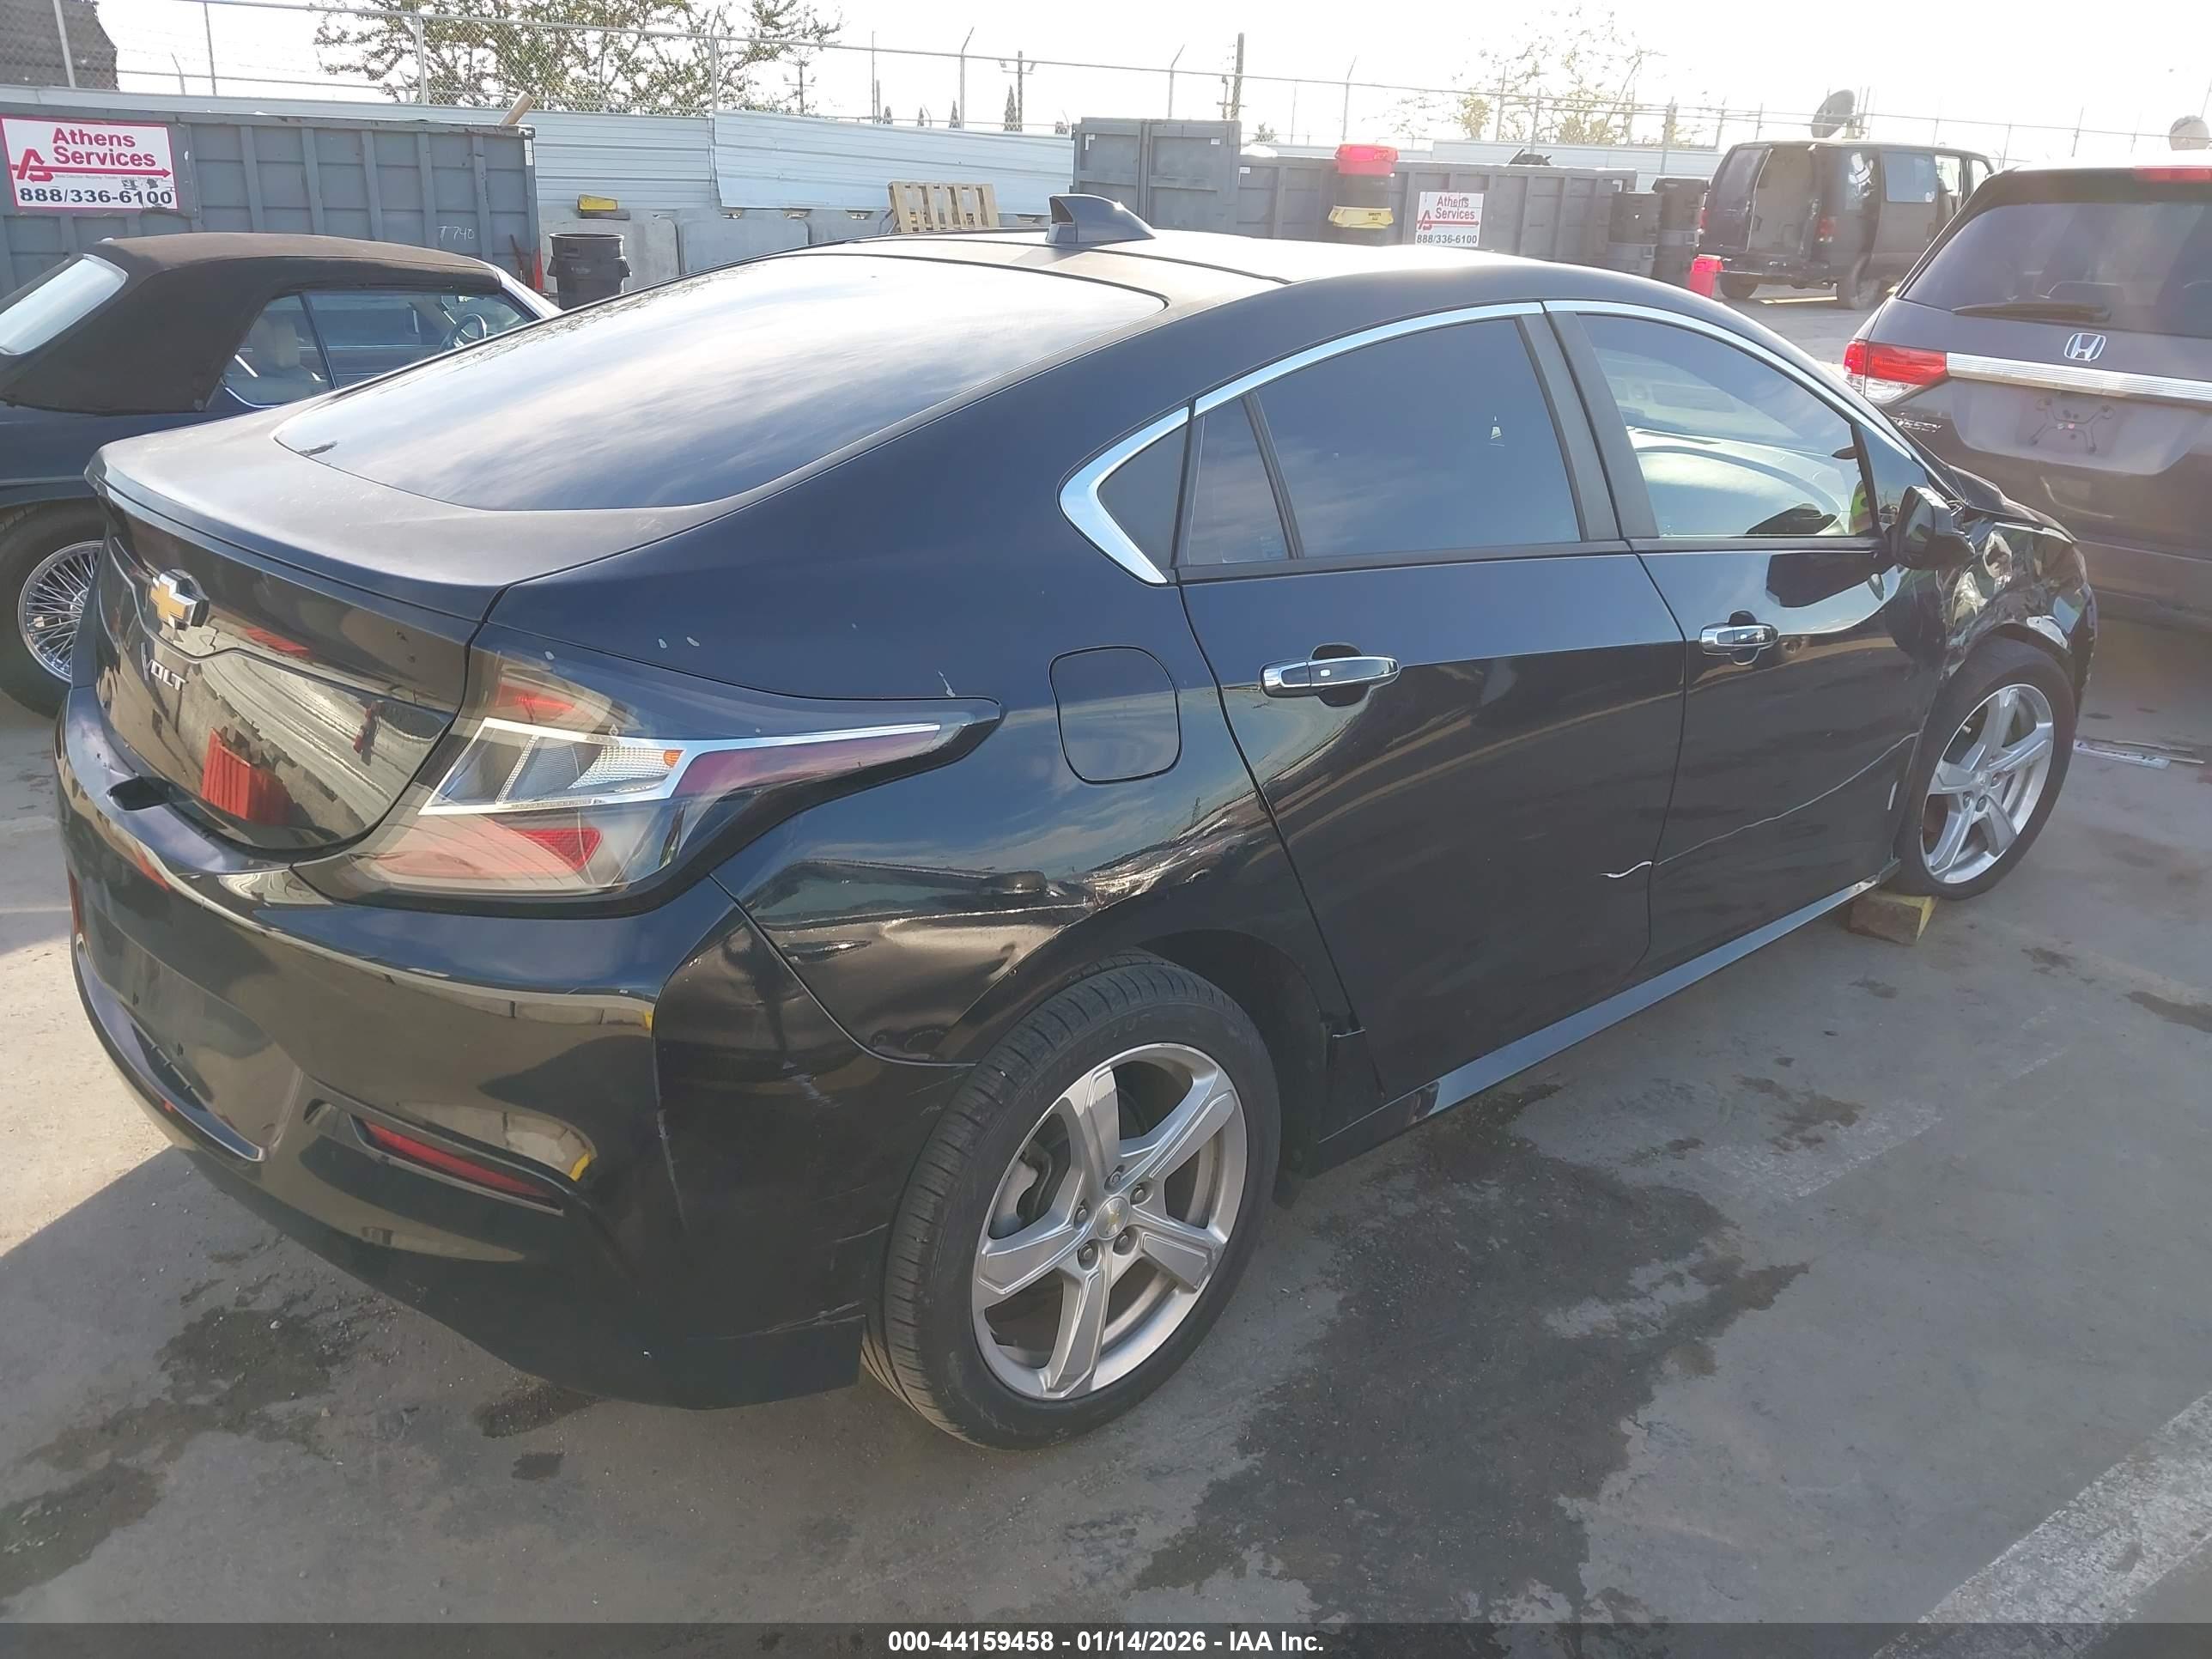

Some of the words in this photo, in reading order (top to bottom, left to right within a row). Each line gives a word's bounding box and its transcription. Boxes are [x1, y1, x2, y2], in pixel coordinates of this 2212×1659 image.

[52, 127, 136, 147] Athens
[54, 146, 156, 167] Services
[19, 187, 173, 204] 888/336-6100
[1437, 195, 1469, 208] Athens
[1435, 207, 1475, 220] Services
[1416, 234, 1478, 244] 888/336-6100
[140, 641, 186, 690] VOLT
